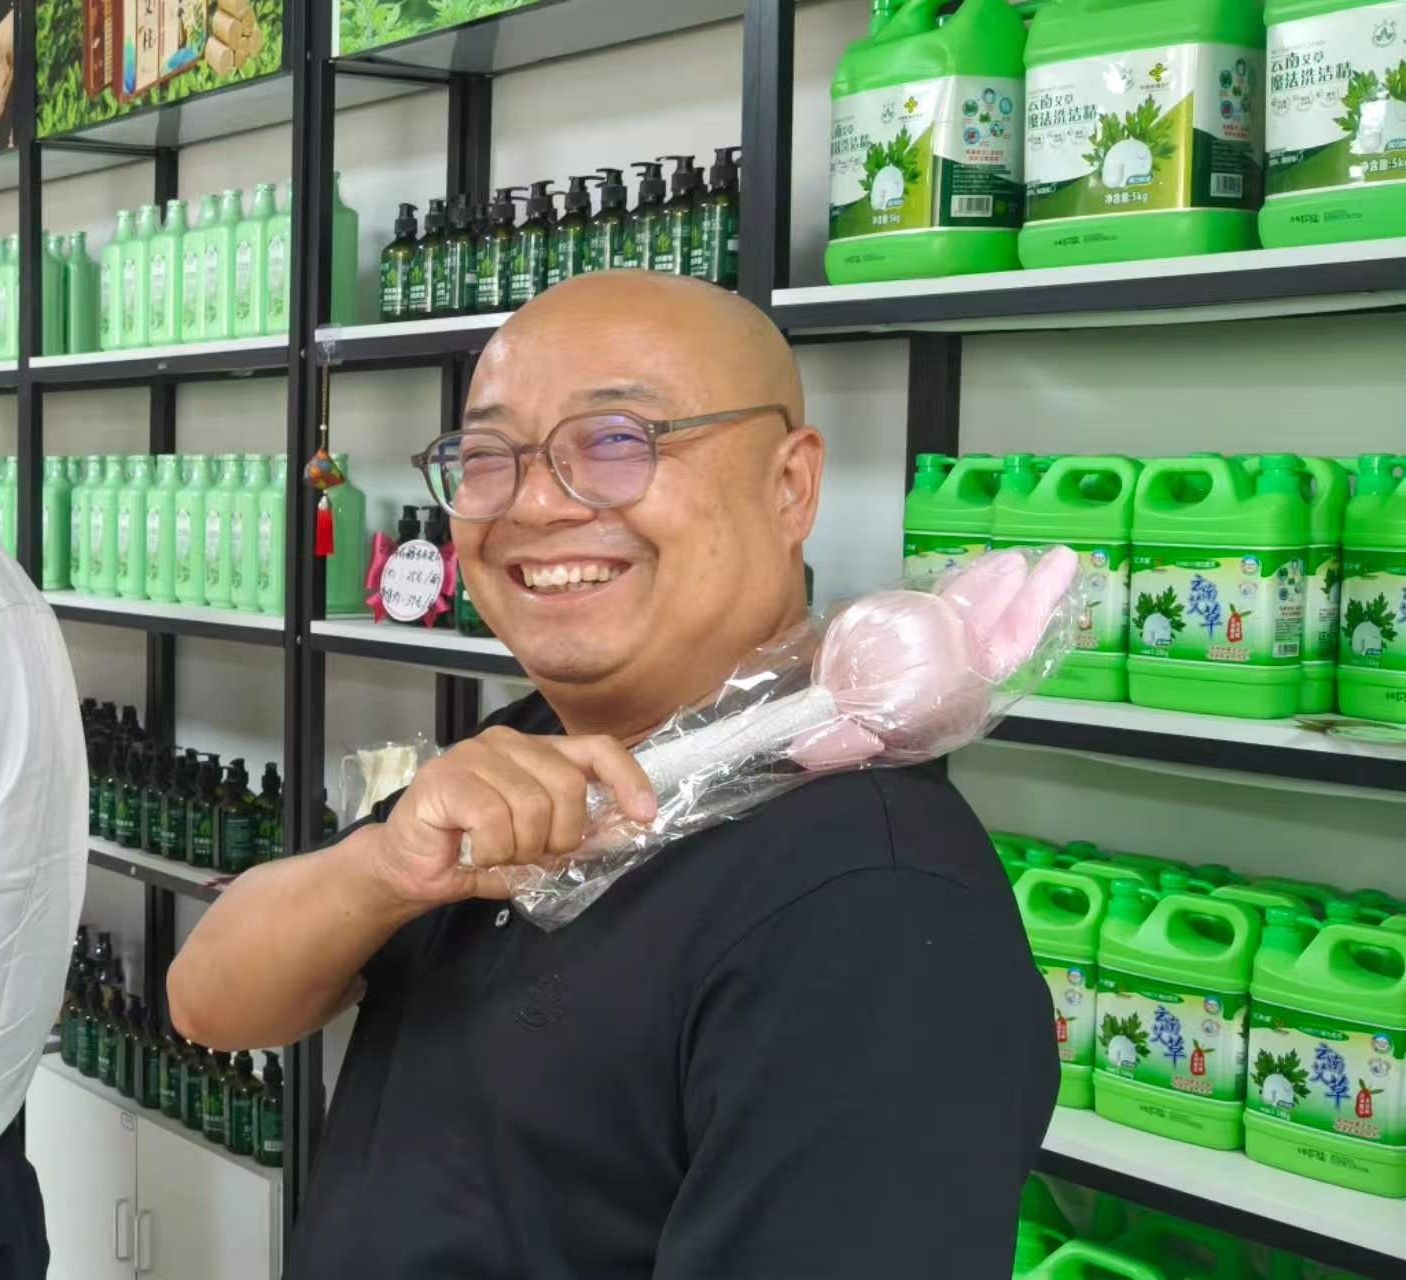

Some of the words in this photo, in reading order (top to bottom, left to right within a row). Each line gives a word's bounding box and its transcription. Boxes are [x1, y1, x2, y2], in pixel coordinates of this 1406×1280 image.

[1271, 51, 1324, 73] 云南艾草
[1271, 61, 1352, 93] 魔法洗洁精
[1028, 94, 1074, 112] 云南艾草
[1028, 104, 1097, 129] 魔法洗洁精
